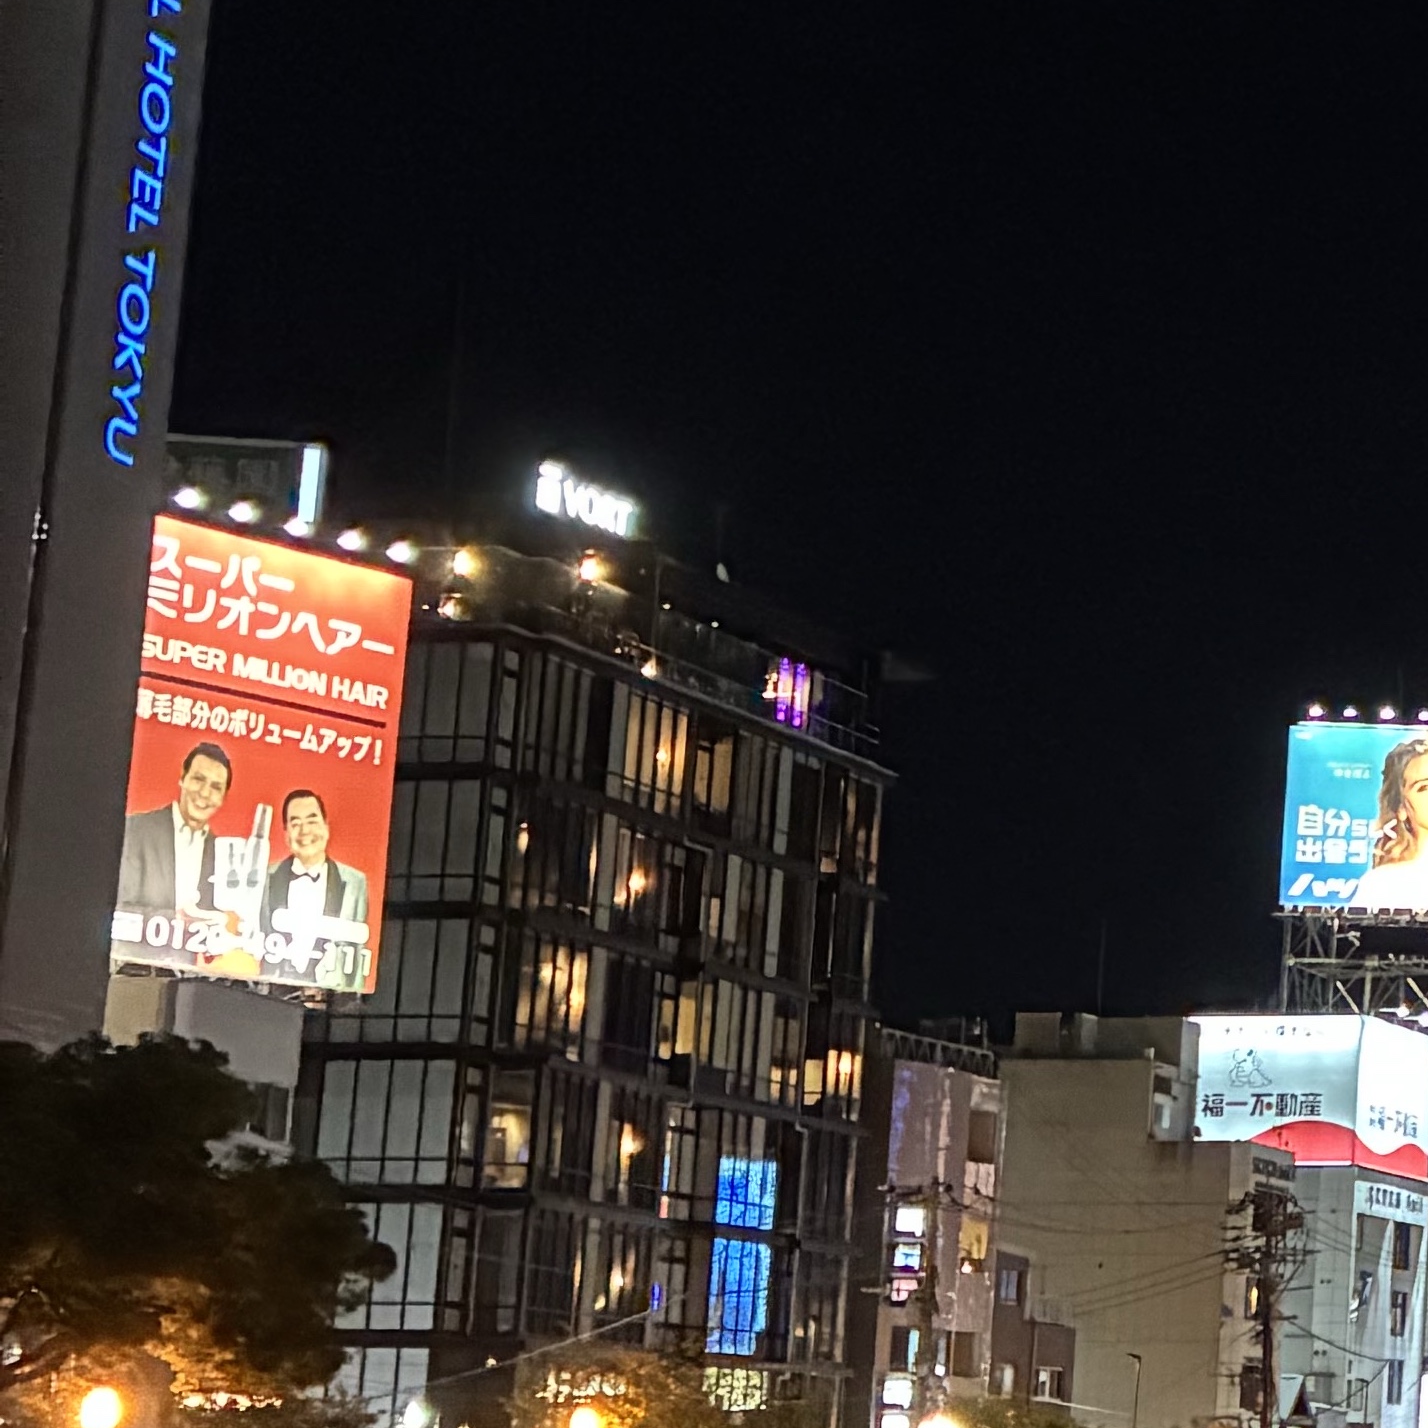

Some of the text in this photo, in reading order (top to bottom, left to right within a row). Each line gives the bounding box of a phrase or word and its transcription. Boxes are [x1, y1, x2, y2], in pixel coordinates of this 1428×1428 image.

[126, 31, 176, 233] HOTEL
[104, 250, 157, 467] TOKYU
[150, 535, 295, 597] スーパー
[147, 575, 395, 655] ミリオンヘアー
[142, 634, 389, 710] SUPER MILLION HAIR
[1201, 1092, 1324, 1118] 福一不動産
